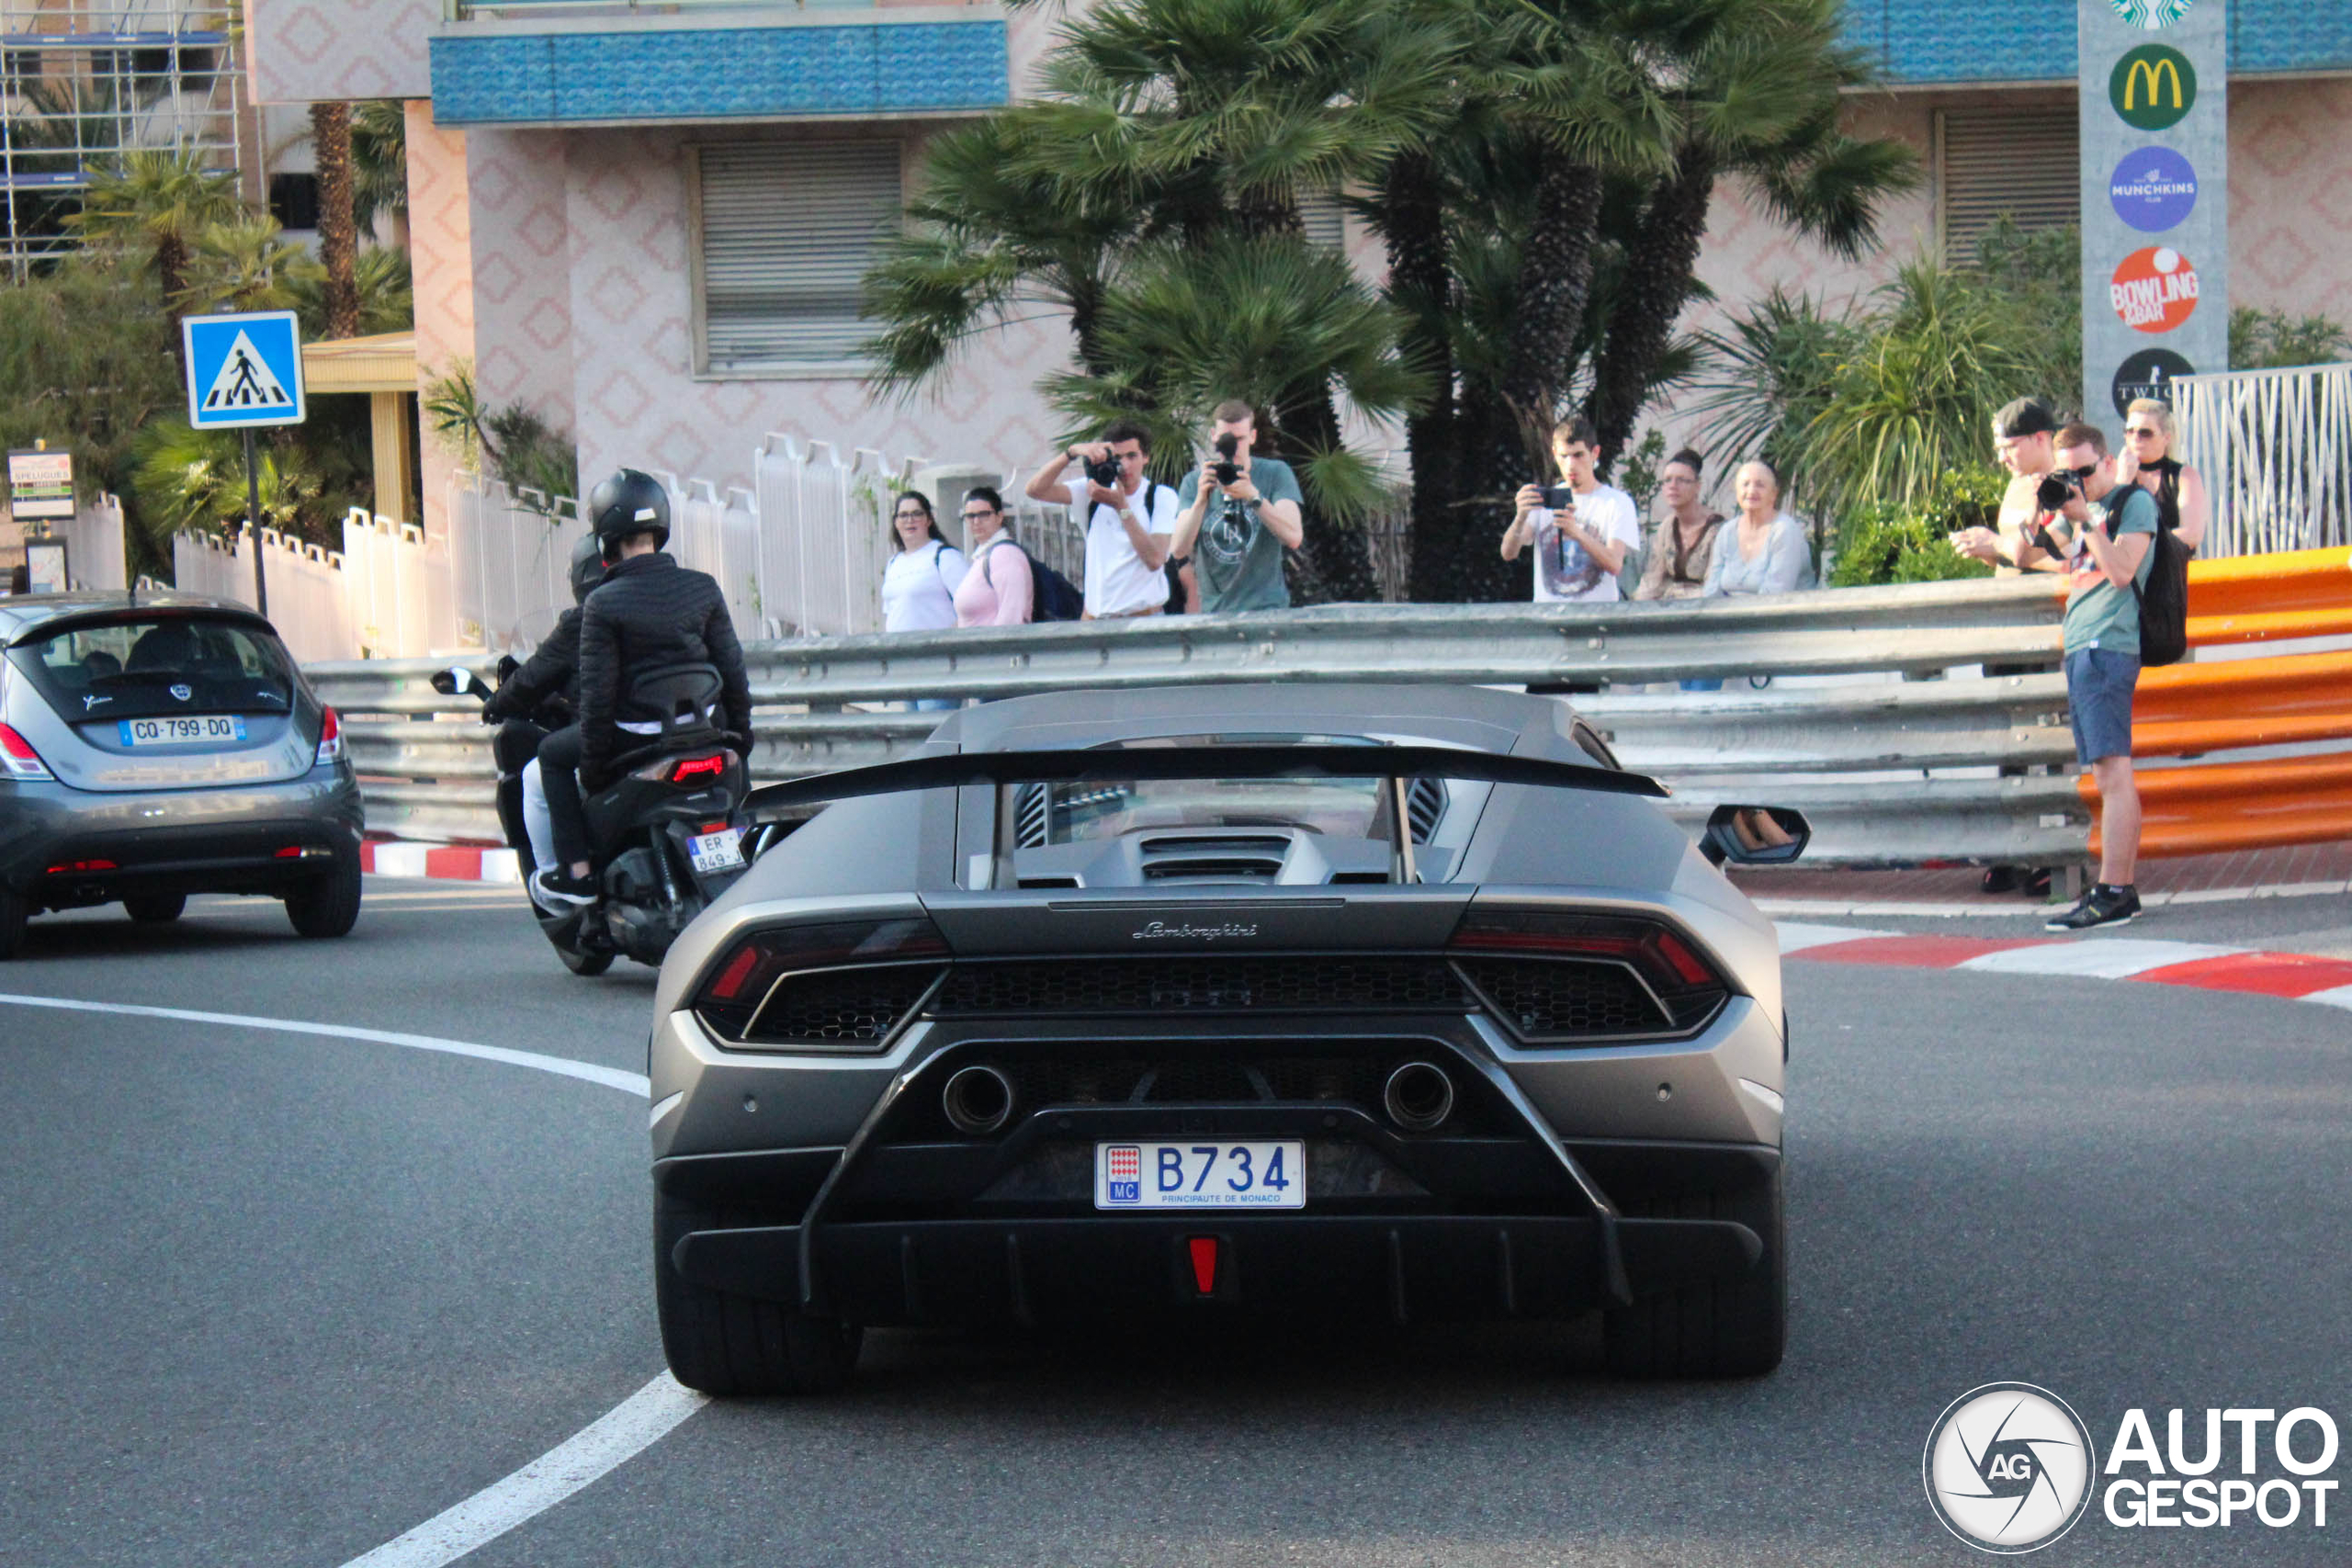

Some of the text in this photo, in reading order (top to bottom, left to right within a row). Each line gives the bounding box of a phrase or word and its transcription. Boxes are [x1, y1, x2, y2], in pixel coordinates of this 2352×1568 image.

[2112, 183, 2195, 197] MUNCHKINS
[2110, 271, 2199, 310] BOWLING
[2124, 303, 2165, 326] &BAR
[1133, 921, 1258, 941] Lamborghini
[1158, 1146, 1289, 1192] B734
[1114, 1183, 1135, 1199] MC
[1161, 1194, 1281, 1203] PRINCIPAUTE DE MONACO
